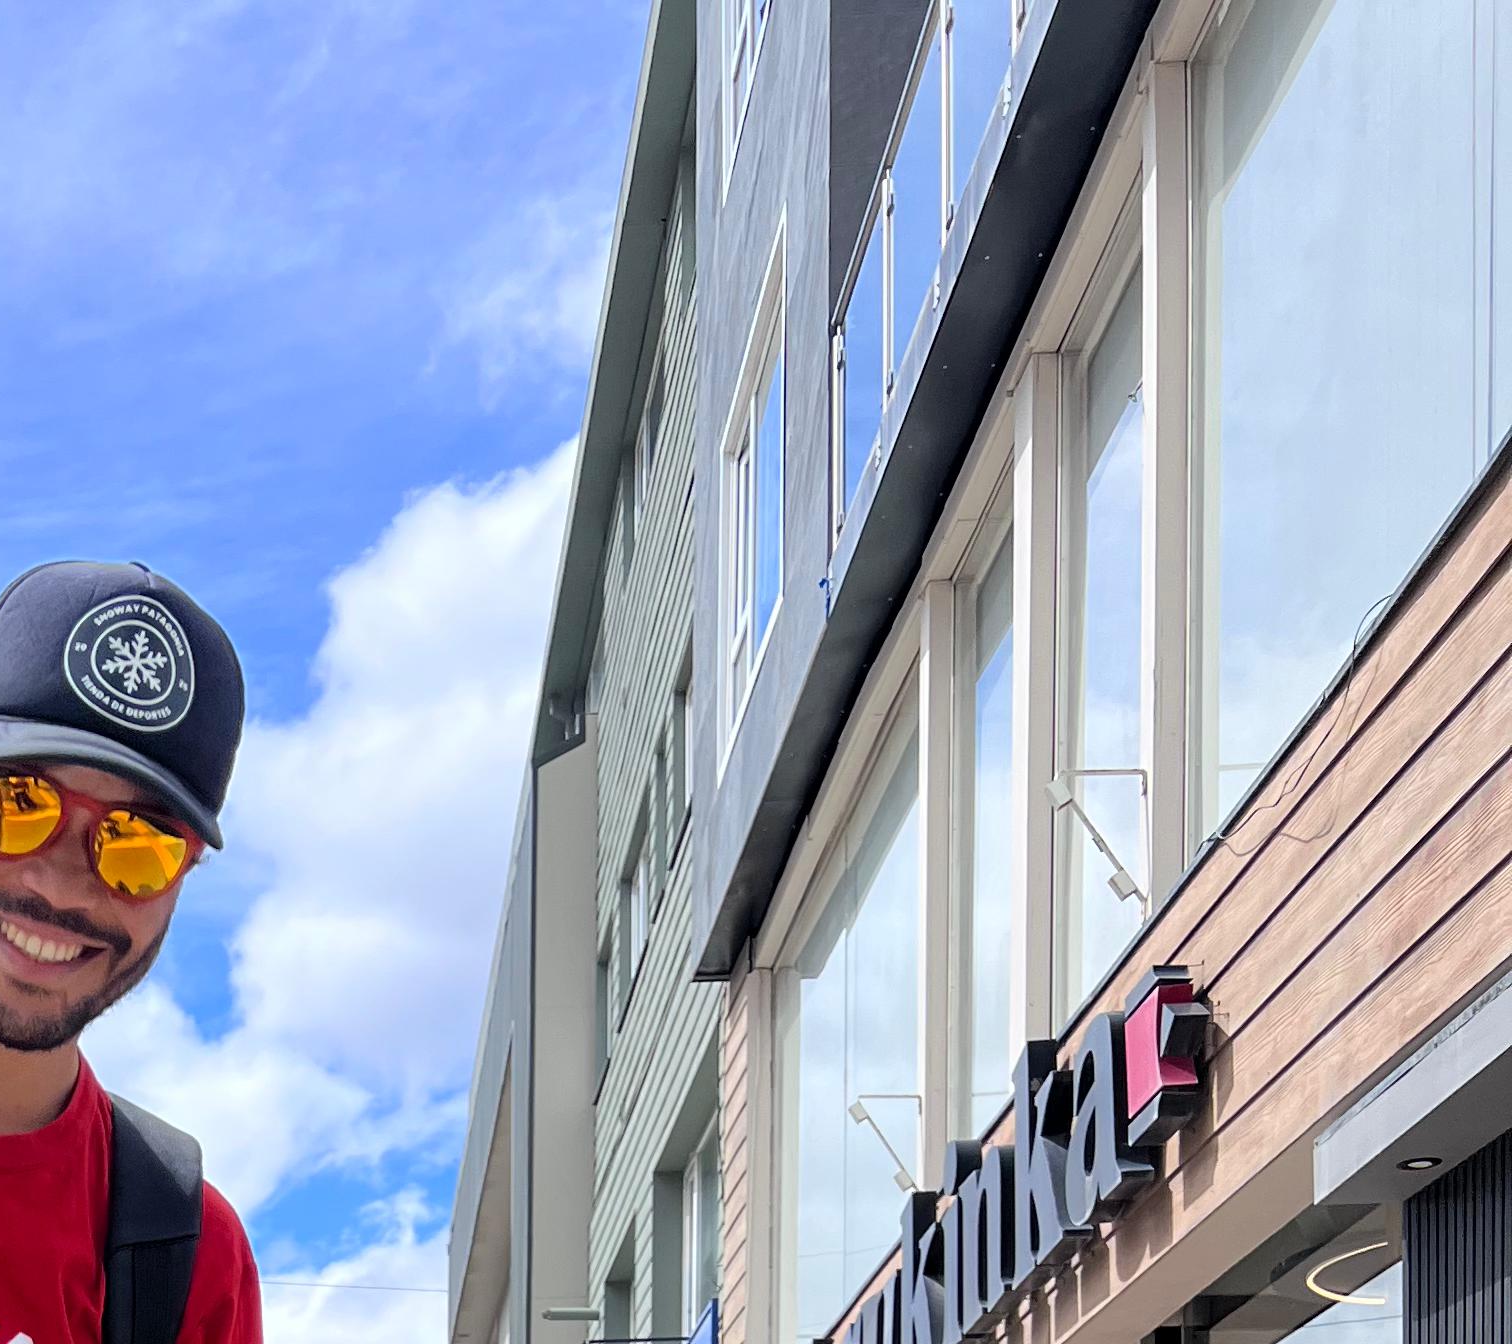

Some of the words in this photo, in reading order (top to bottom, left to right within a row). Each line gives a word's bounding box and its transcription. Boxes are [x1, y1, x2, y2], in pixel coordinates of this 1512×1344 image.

[93, 604, 140, 626] SNOWAY
[141, 604, 185, 657] PATAGONIA
[81, 674, 110, 705] TIENDA
[111, 700, 125, 714] DE
[126, 706, 172, 721] DEPORTES
